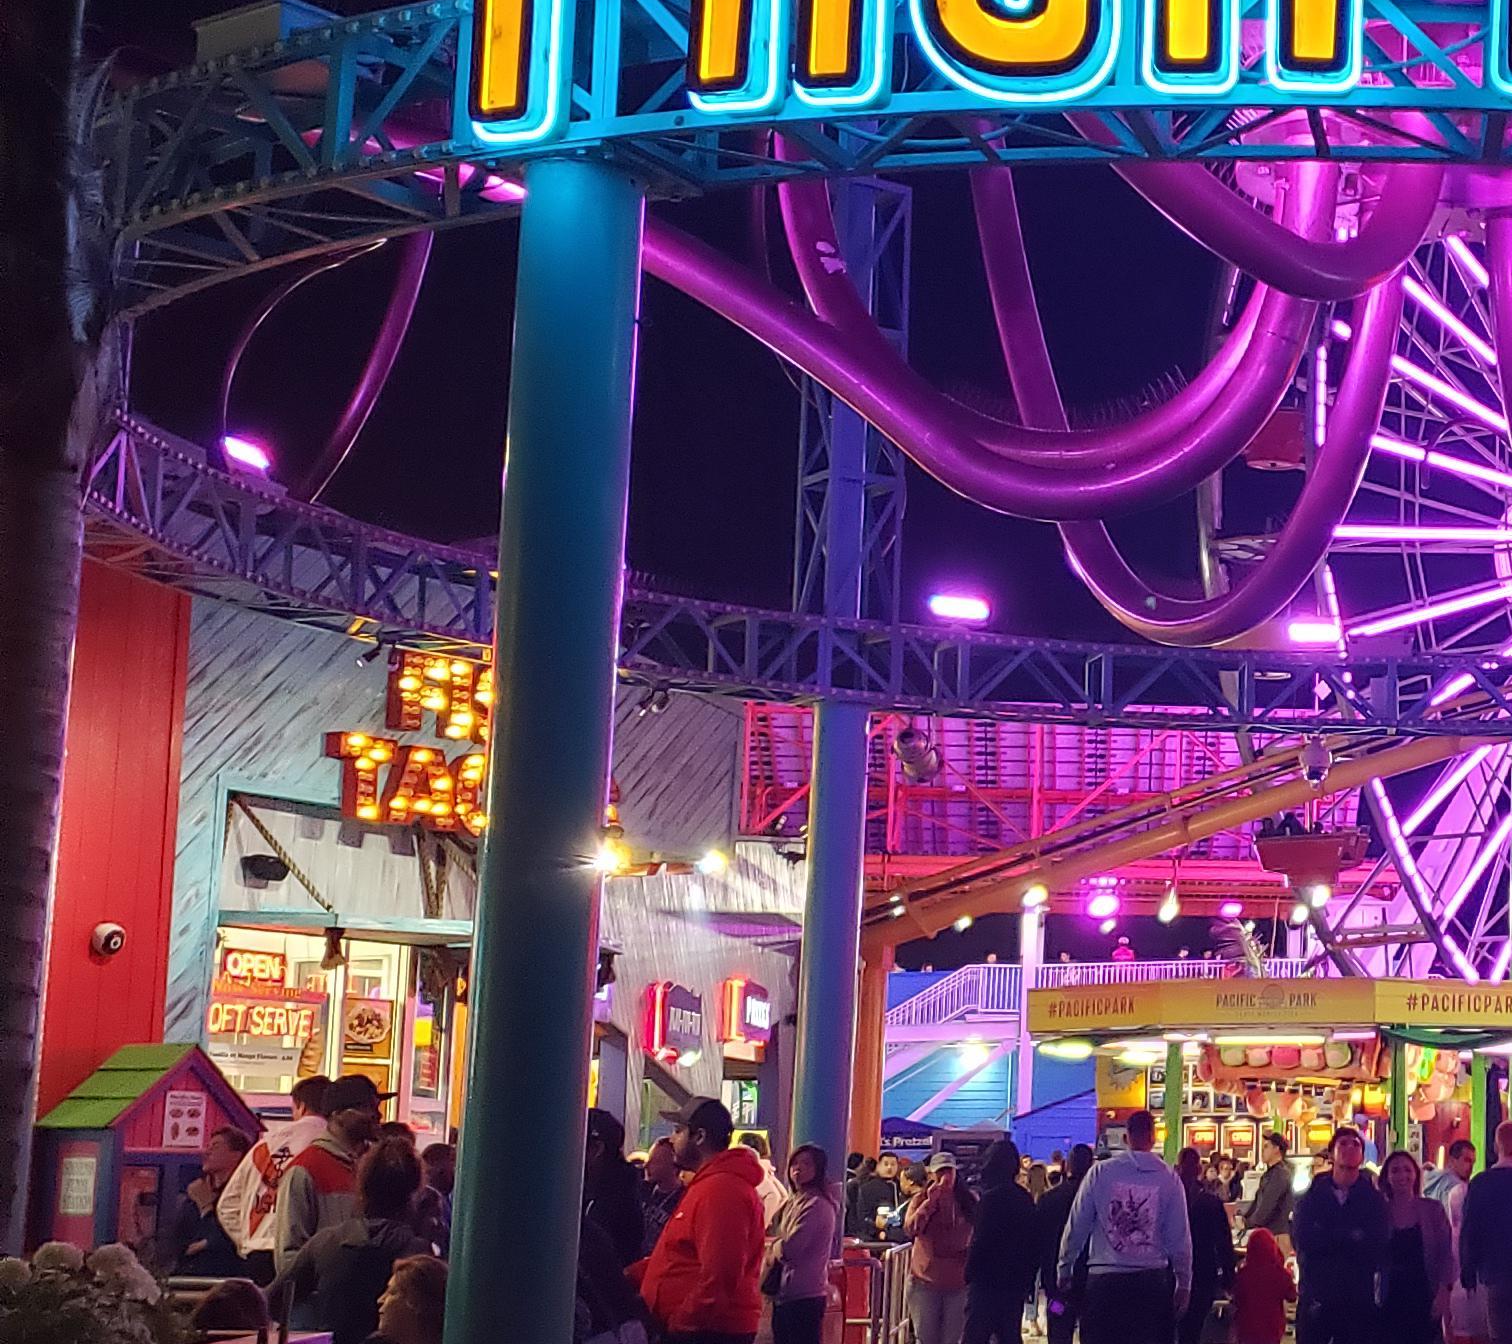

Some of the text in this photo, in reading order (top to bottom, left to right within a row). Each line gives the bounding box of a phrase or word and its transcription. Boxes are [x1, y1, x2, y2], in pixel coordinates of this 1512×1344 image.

[226, 952, 282, 980] OPEN
[1048, 996, 1135, 1019] #PACIFICPARK
[1216, 992, 1317, 1008] PACIFIC PARK
[208, 1002, 314, 1038] OFT SERVE
